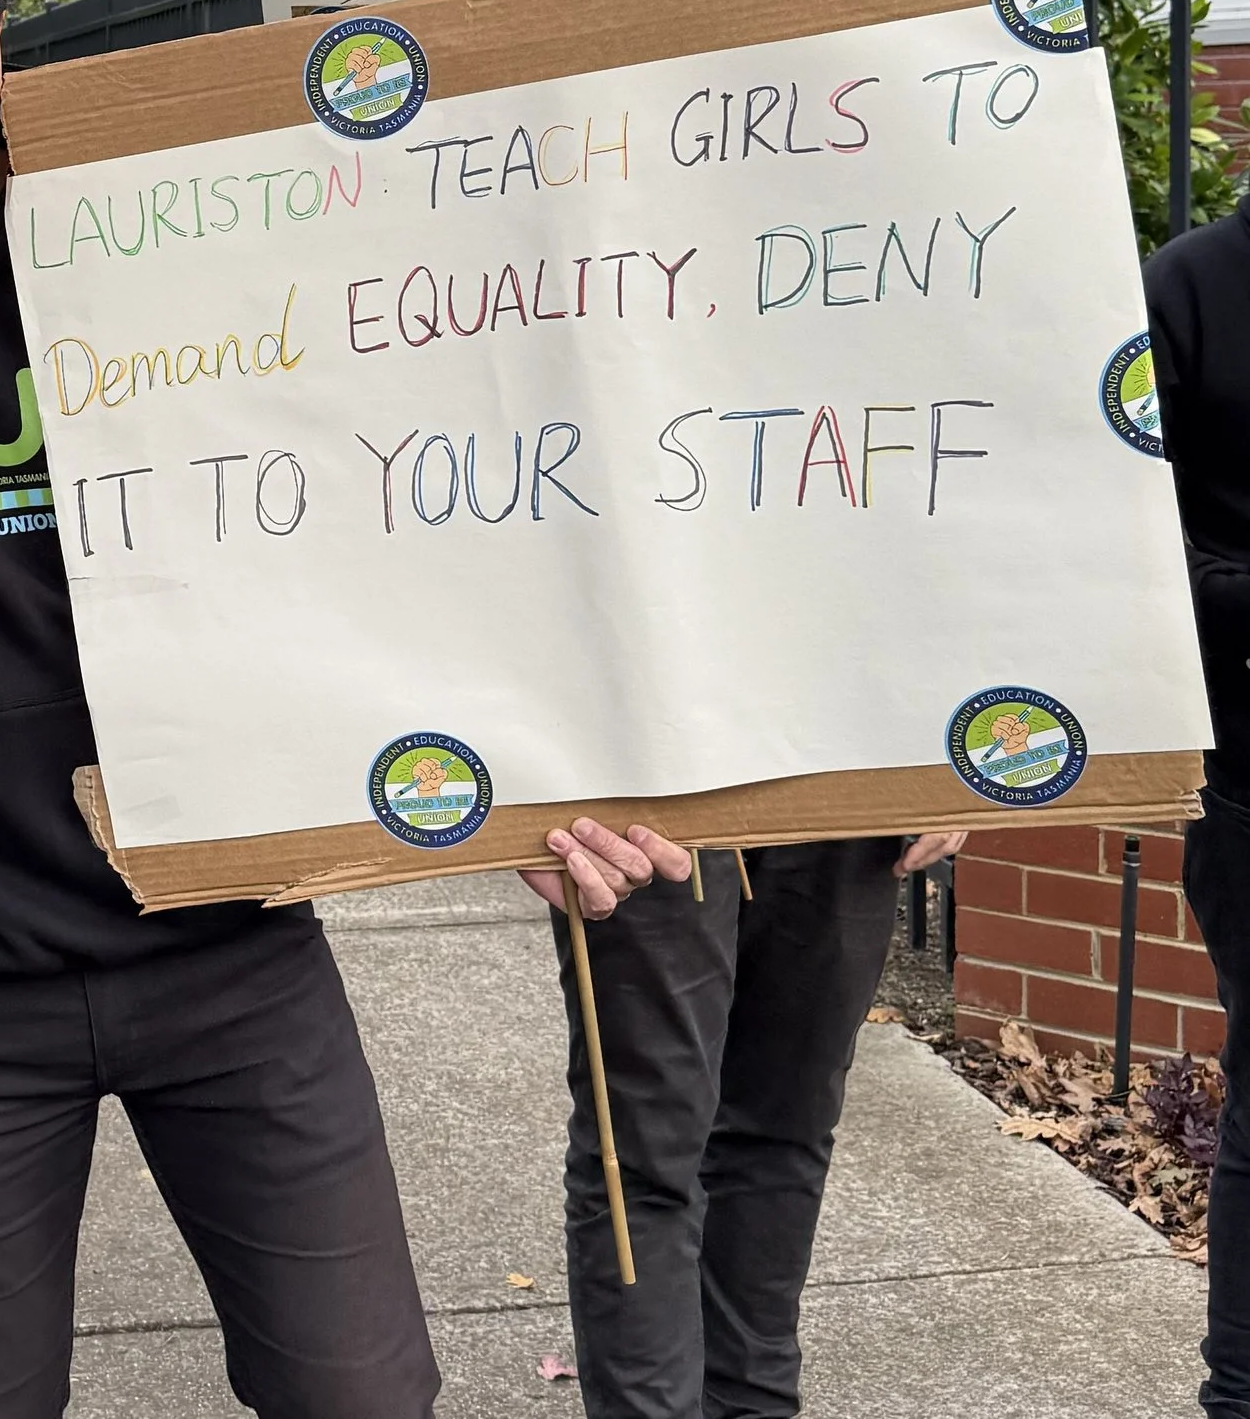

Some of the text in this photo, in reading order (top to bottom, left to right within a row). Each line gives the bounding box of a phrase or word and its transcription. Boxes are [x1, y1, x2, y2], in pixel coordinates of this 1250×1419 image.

[340, 21, 405, 41] EDUCATION
[408, 45, 425, 82] UNION
[1026, 30, 1081, 48] VICTORIA
[406, 110, 629, 209] TEACH
[670, 77, 880, 168] GIRLS
[922, 61, 1040, 145] TO
[43, 282, 307, 417] Demand
[755, 206, 1017, 316] DENY
[1107, 352, 1130, 433] INDEPENDENT
[14, 472, 50, 483] TASMANI
[72, 399, 994, 558] IT TO YOUR STAFF
[981, 690, 1054, 709] EDUCATION
[1060, 713, 1085, 749] UNION
[413, 736, 477, 764] EDUCATION
[477, 771, 490, 806] UNION
